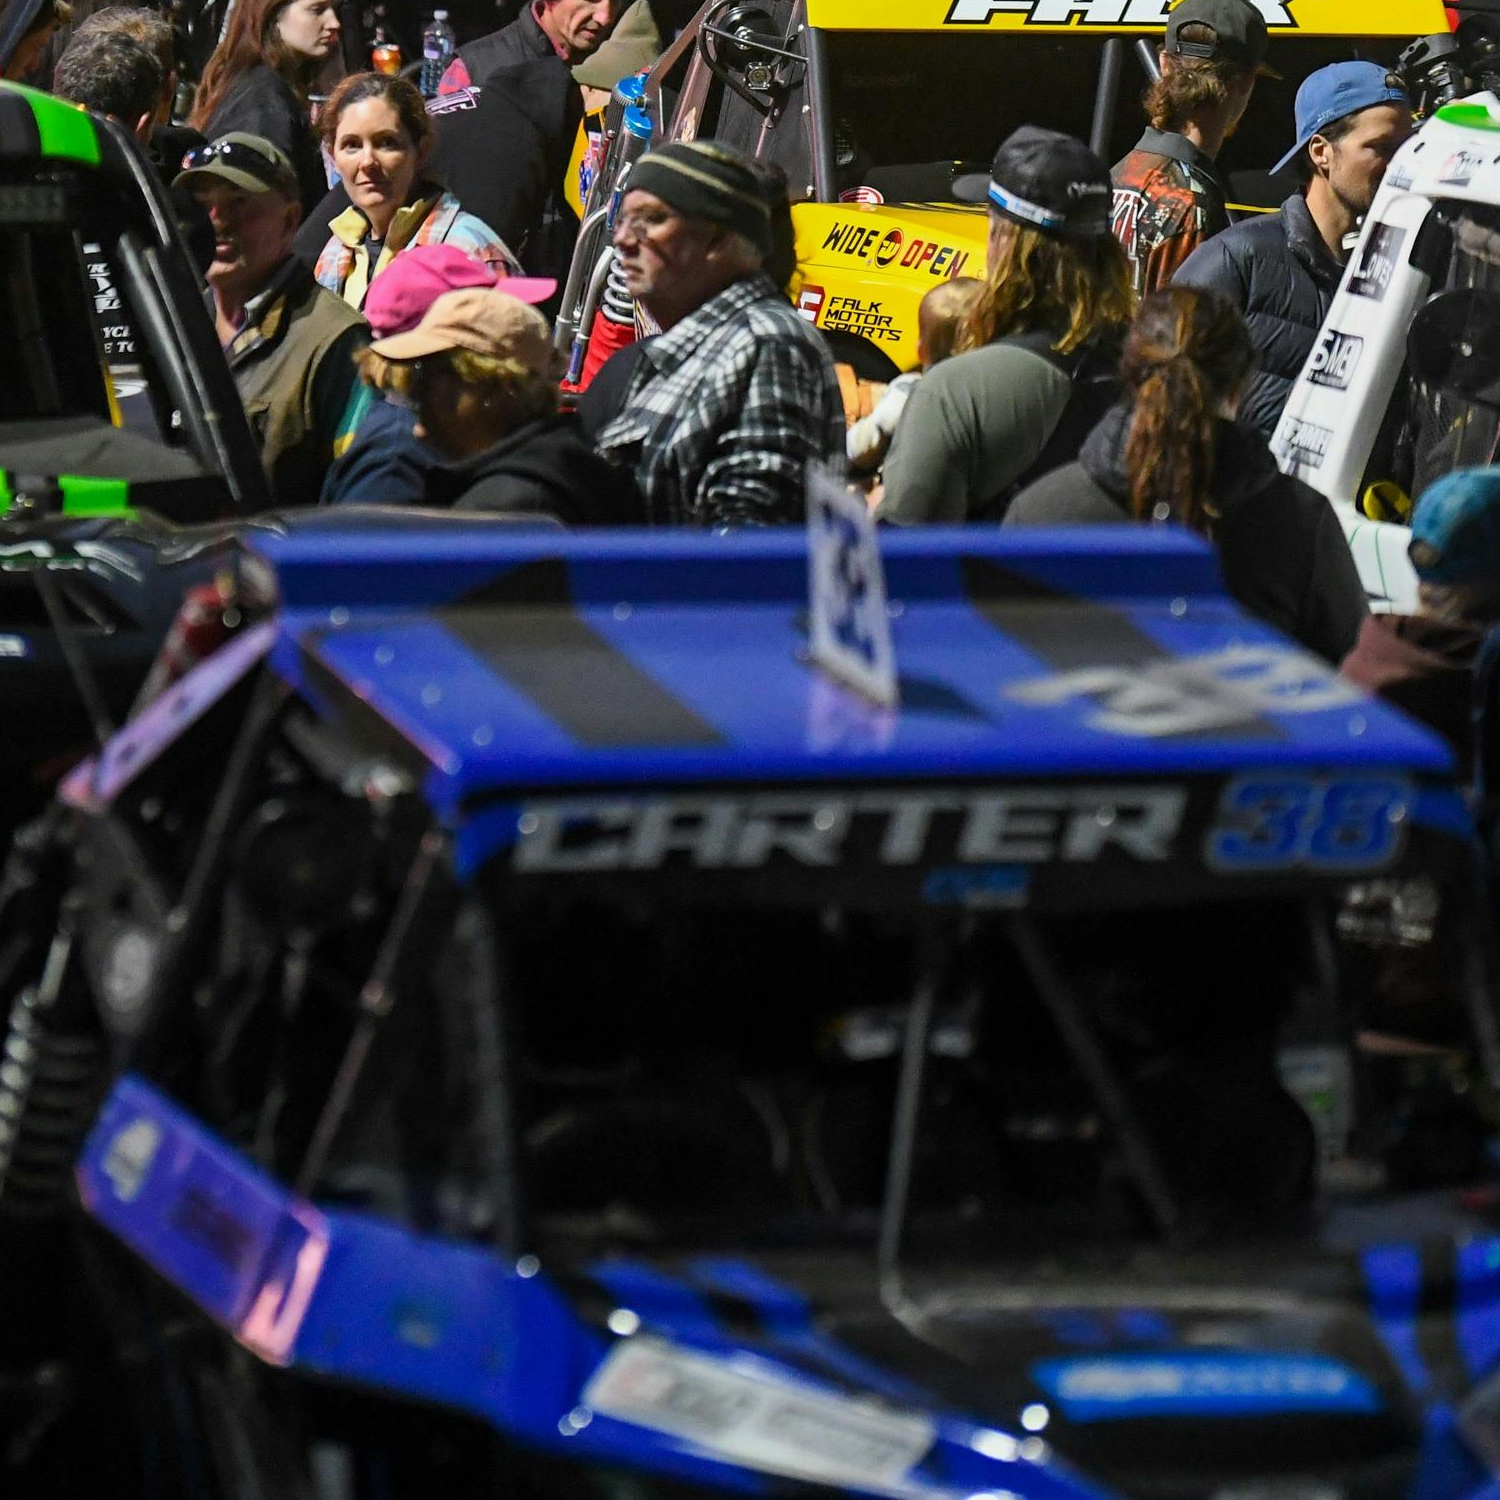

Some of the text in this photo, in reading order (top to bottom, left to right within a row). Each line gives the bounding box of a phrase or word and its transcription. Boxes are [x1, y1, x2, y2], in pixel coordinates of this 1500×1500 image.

[822, 222, 969, 279] WIDE OPEN
[828, 296, 883, 313] FALK
[825, 308, 894, 327] MOTOR
[823, 321, 903, 342] SPORTS
[511, 768, 1414, 874] CARTER 38
